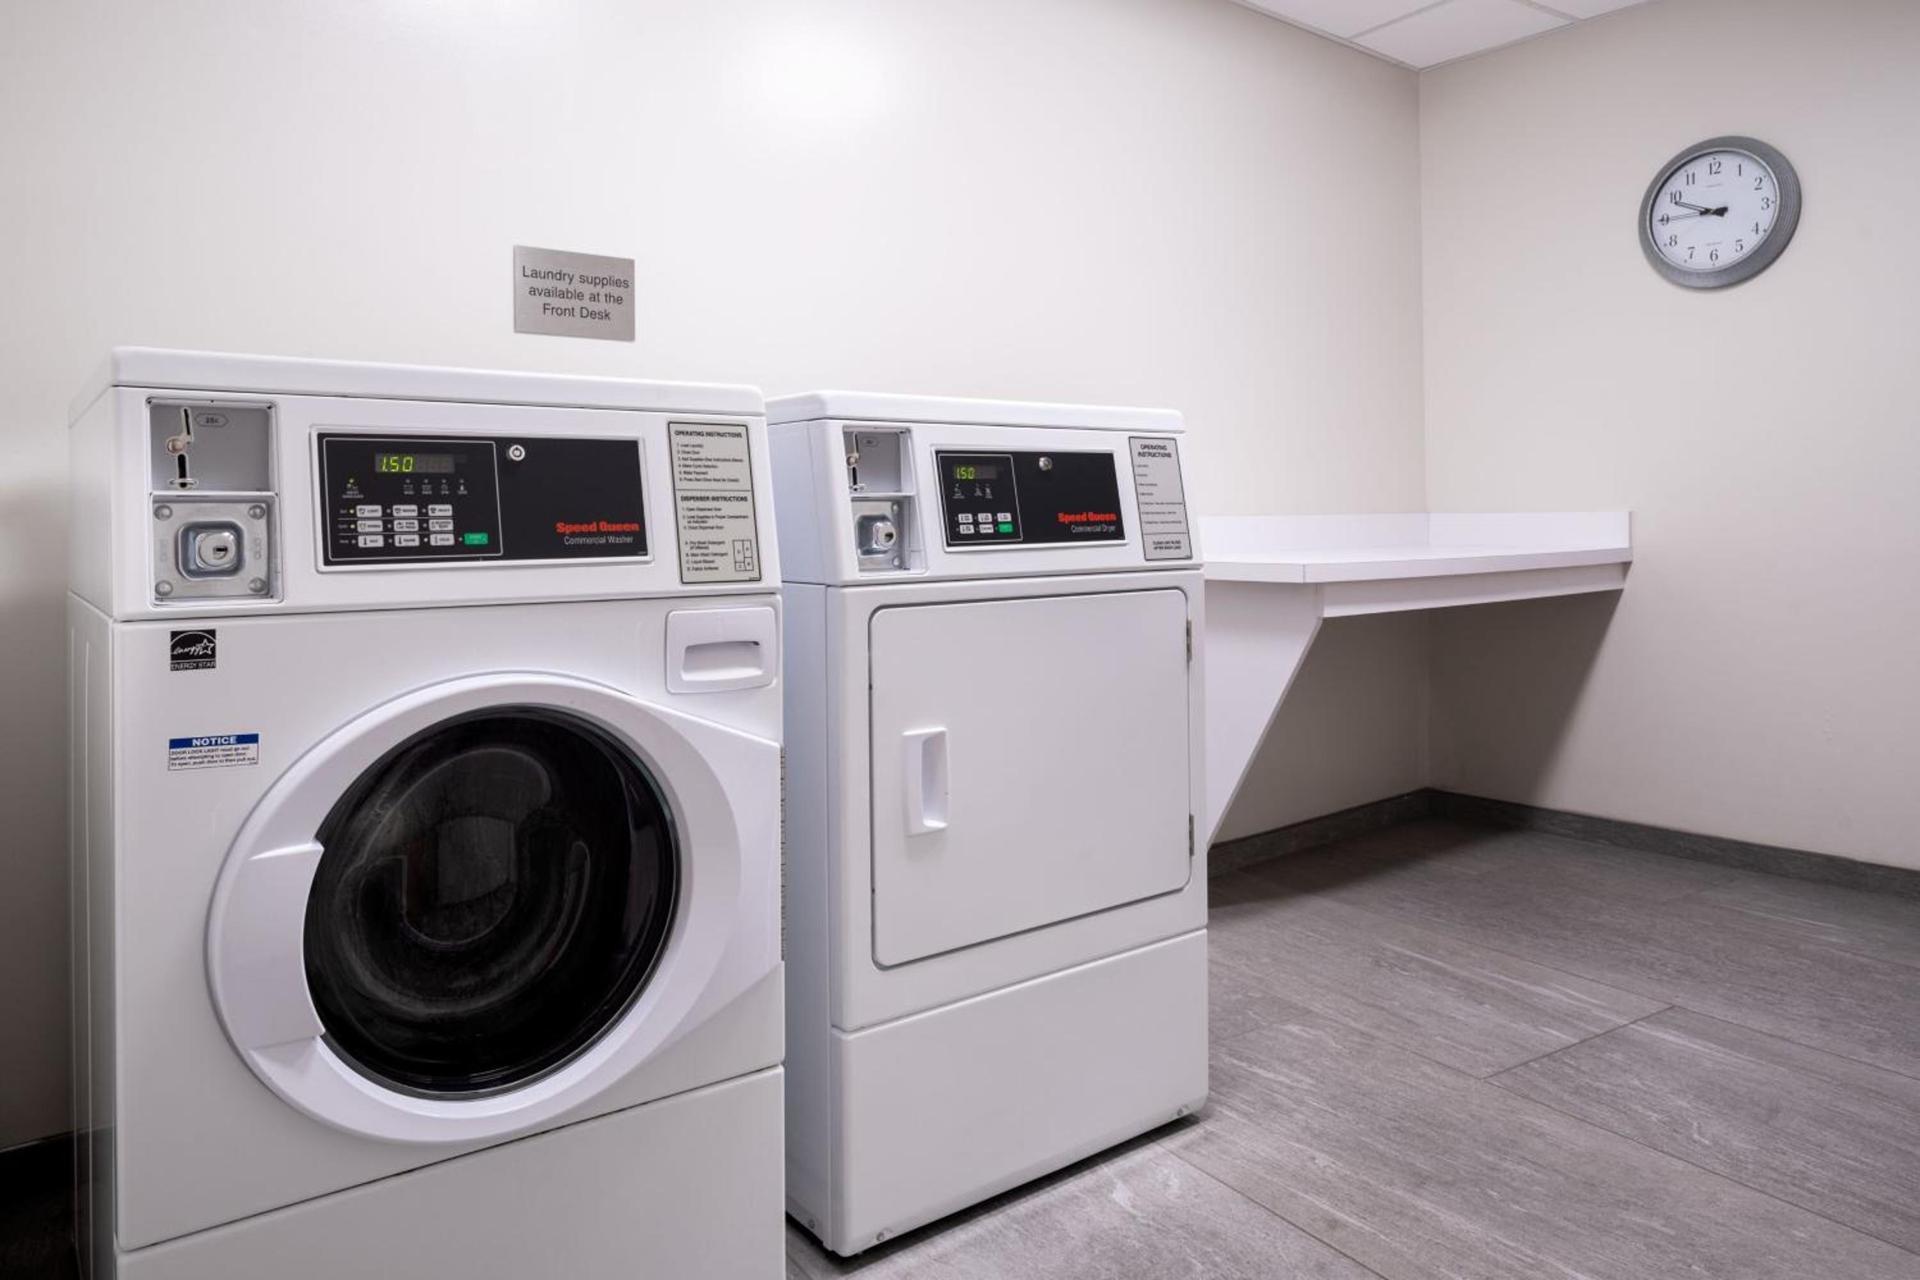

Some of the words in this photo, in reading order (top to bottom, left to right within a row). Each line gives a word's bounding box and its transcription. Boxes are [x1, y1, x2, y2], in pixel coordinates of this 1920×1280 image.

[1709, 161, 1722, 175] 12
[1685, 172, 1696, 186] 11
[1754, 177, 1763, 191] 2
[1669, 190, 1682, 204] 10
[1761, 197, 1770, 210] 3
[1660, 213, 1670, 226] 9
[1751, 222, 1760, 235] 4
[1669, 235, 1678, 247] 8
[1735, 239, 1744, 252] 5
[1687, 247, 1695, 259] 7
[1709, 248, 1719, 262] 6
[522, 265, 574, 285] Laundry
[579, 274, 630, 289] supplies
[528, 286, 584, 301] available
[589, 293, 601, 303] at
[604, 291, 623, 305] the
[543, 303, 575, 317] Front
[580, 306, 611, 321] Desk
[1058, 512, 1087, 524] Speed
[1087, 512, 1117, 521] Queen
[556, 522, 597, 534] Speed
[599, 521, 640, 531] Queen
[563, 536, 606, 545] Commercial
[171, 662, 197, 671] ENERGY
[198, 661, 216, 669] STAR
[192, 736, 237, 747] NOTICE
